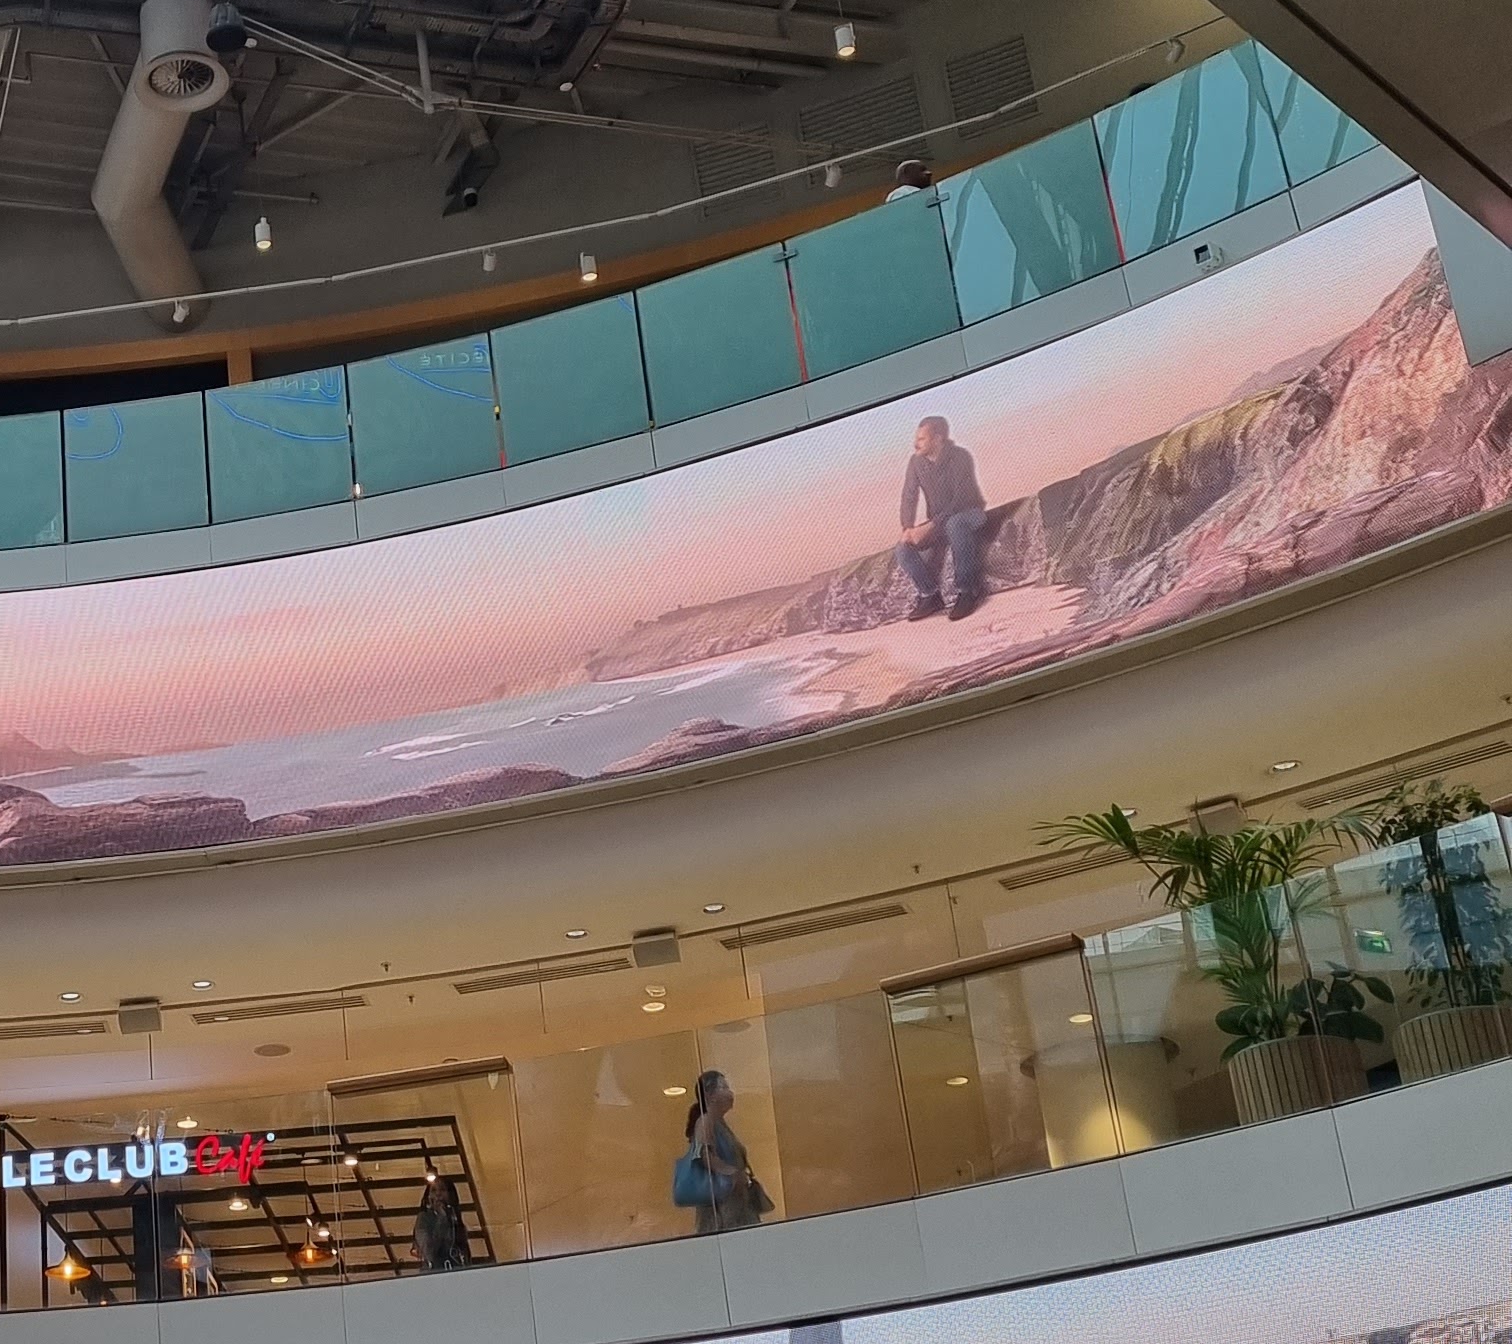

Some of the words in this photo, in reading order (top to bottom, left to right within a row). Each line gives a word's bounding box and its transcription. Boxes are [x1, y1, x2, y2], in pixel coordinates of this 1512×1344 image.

[2, 1151, 56, 1188] LE
[63, 1142, 188, 1184] CLUB
[195, 1133, 266, 1184] Café
